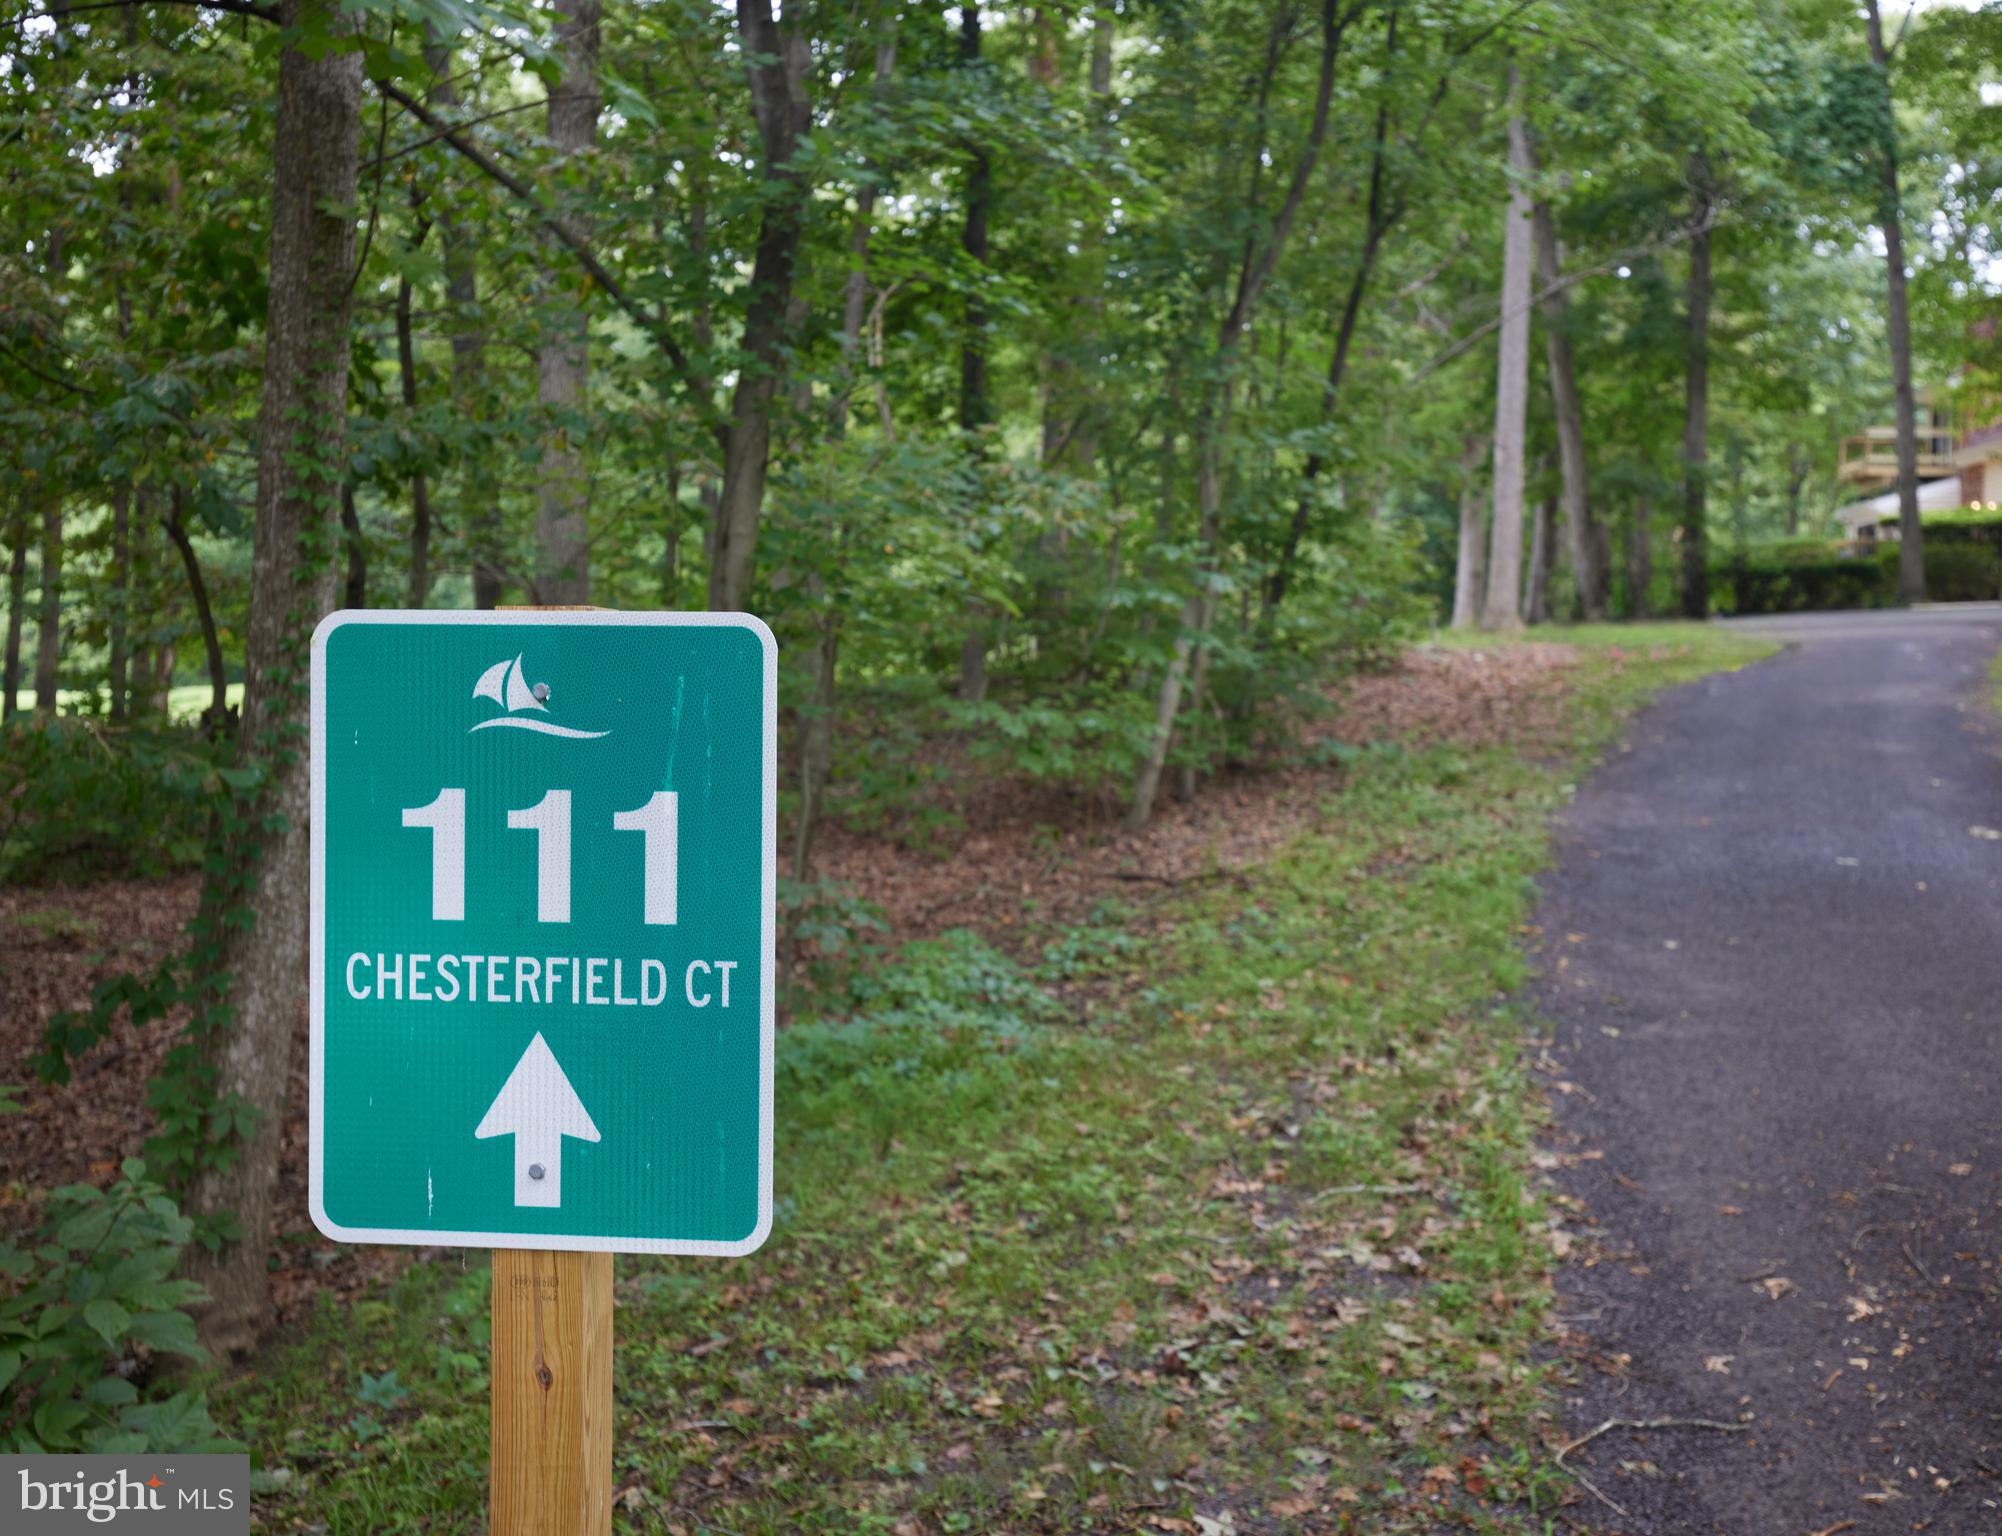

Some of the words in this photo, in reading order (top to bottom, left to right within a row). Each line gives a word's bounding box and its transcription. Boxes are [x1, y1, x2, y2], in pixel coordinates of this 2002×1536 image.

[402, 787, 678, 926] 111
[346, 952, 667, 1007] CHESTERFIELD
[685, 959, 738, 1008] CT
